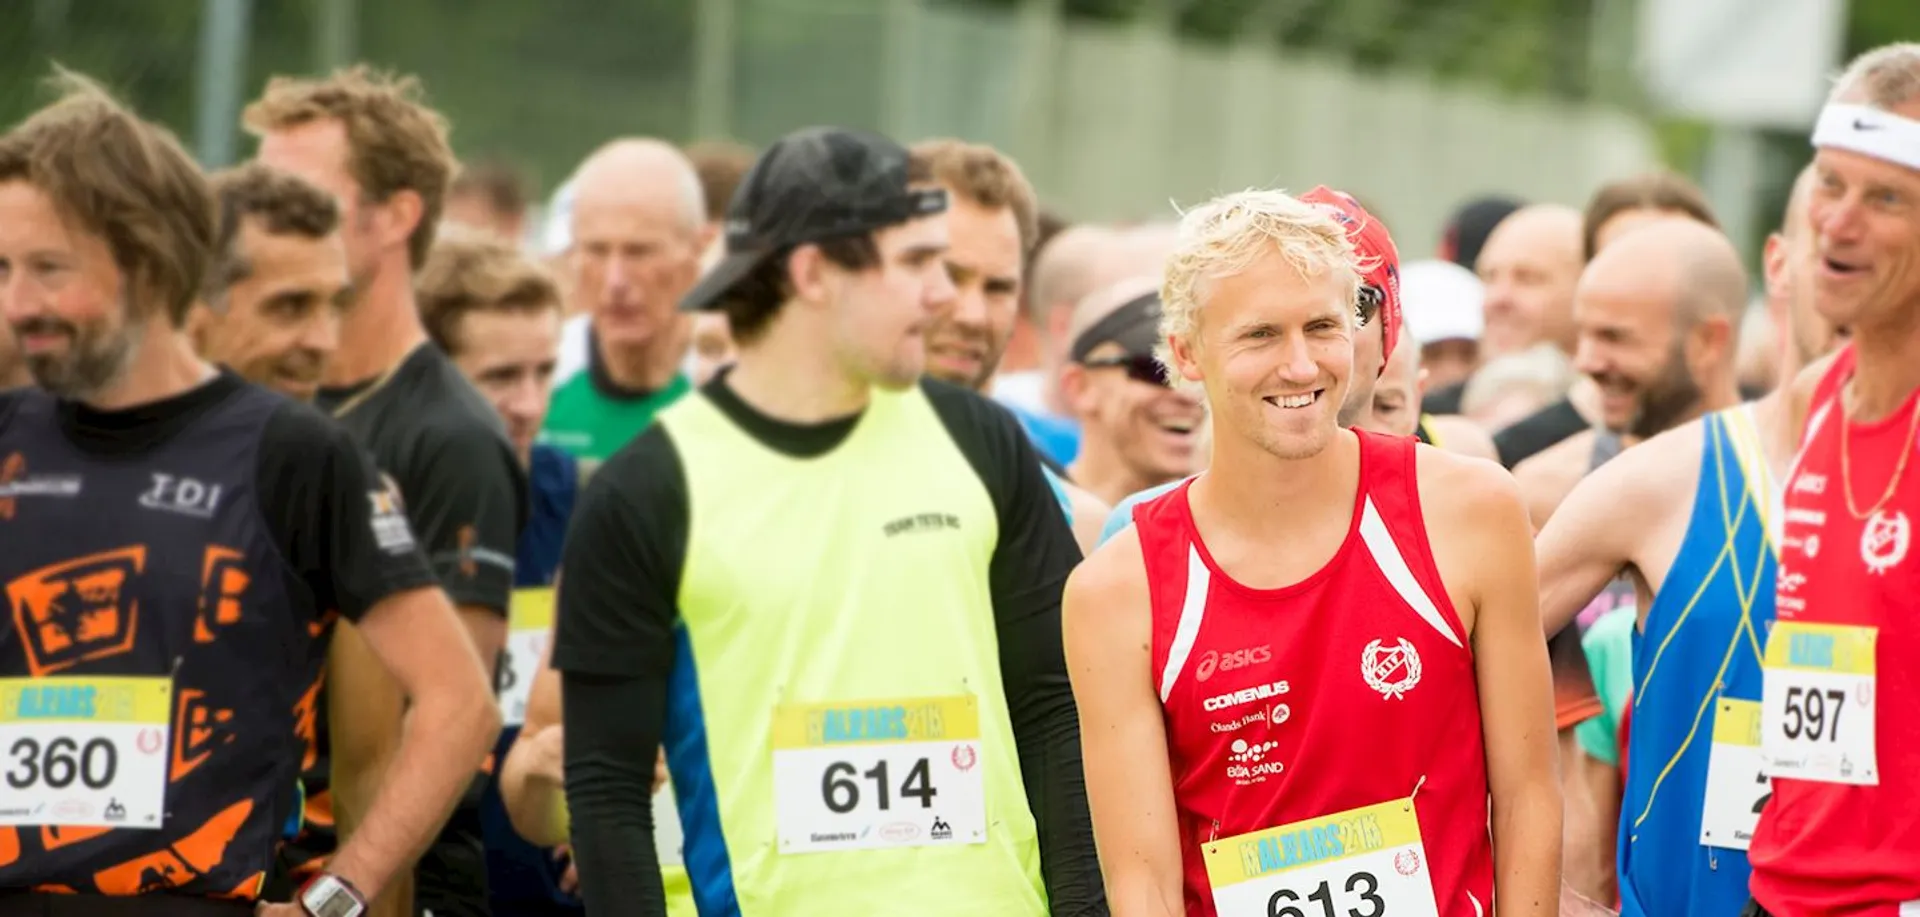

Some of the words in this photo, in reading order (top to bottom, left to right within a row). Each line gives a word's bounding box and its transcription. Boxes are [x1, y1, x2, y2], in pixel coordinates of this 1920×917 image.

[1219, 644, 1273, 672] asics
[1203, 679, 1291, 712] COMENIUS
[1783, 687, 1845, 742] 597
[5, 736, 119, 790] 360
[821, 757, 938, 814] 614
[1251, 761, 1284, 777] SAND
[1266, 871, 1386, 917] 613
